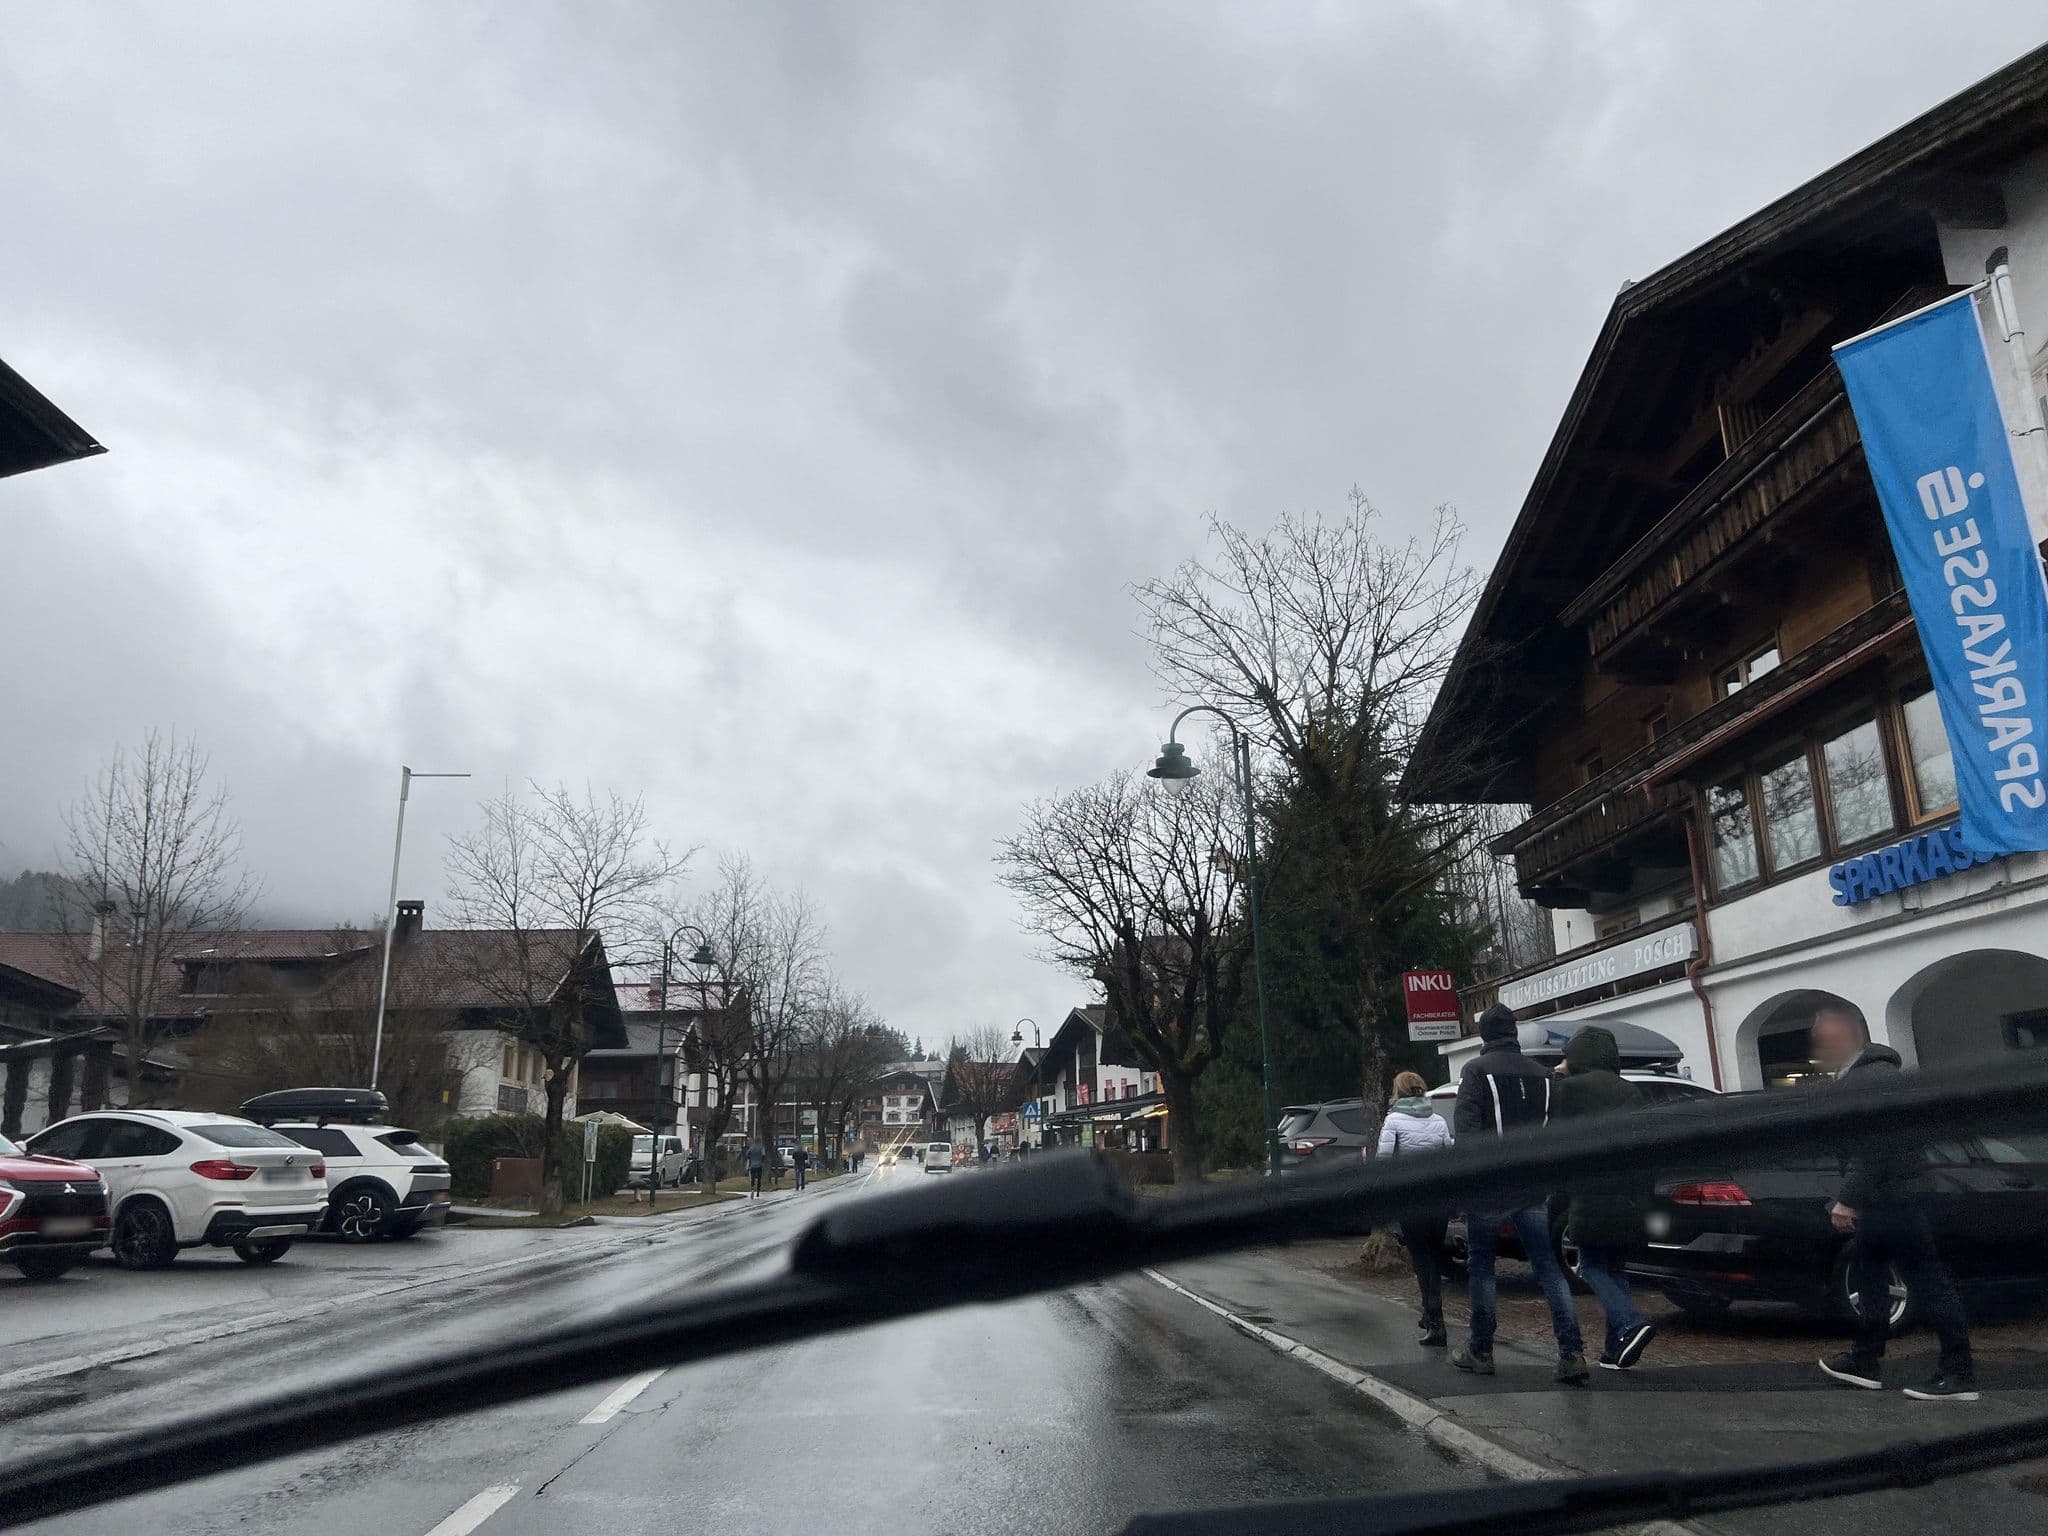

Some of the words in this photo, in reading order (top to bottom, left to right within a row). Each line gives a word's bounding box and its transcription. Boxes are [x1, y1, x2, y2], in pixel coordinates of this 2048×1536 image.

[1408, 974, 1452, 992] INKU
[1503, 957, 1616, 1006] RAUMAUSSTATTUNG
[1634, 933, 1685, 968] POSCH
